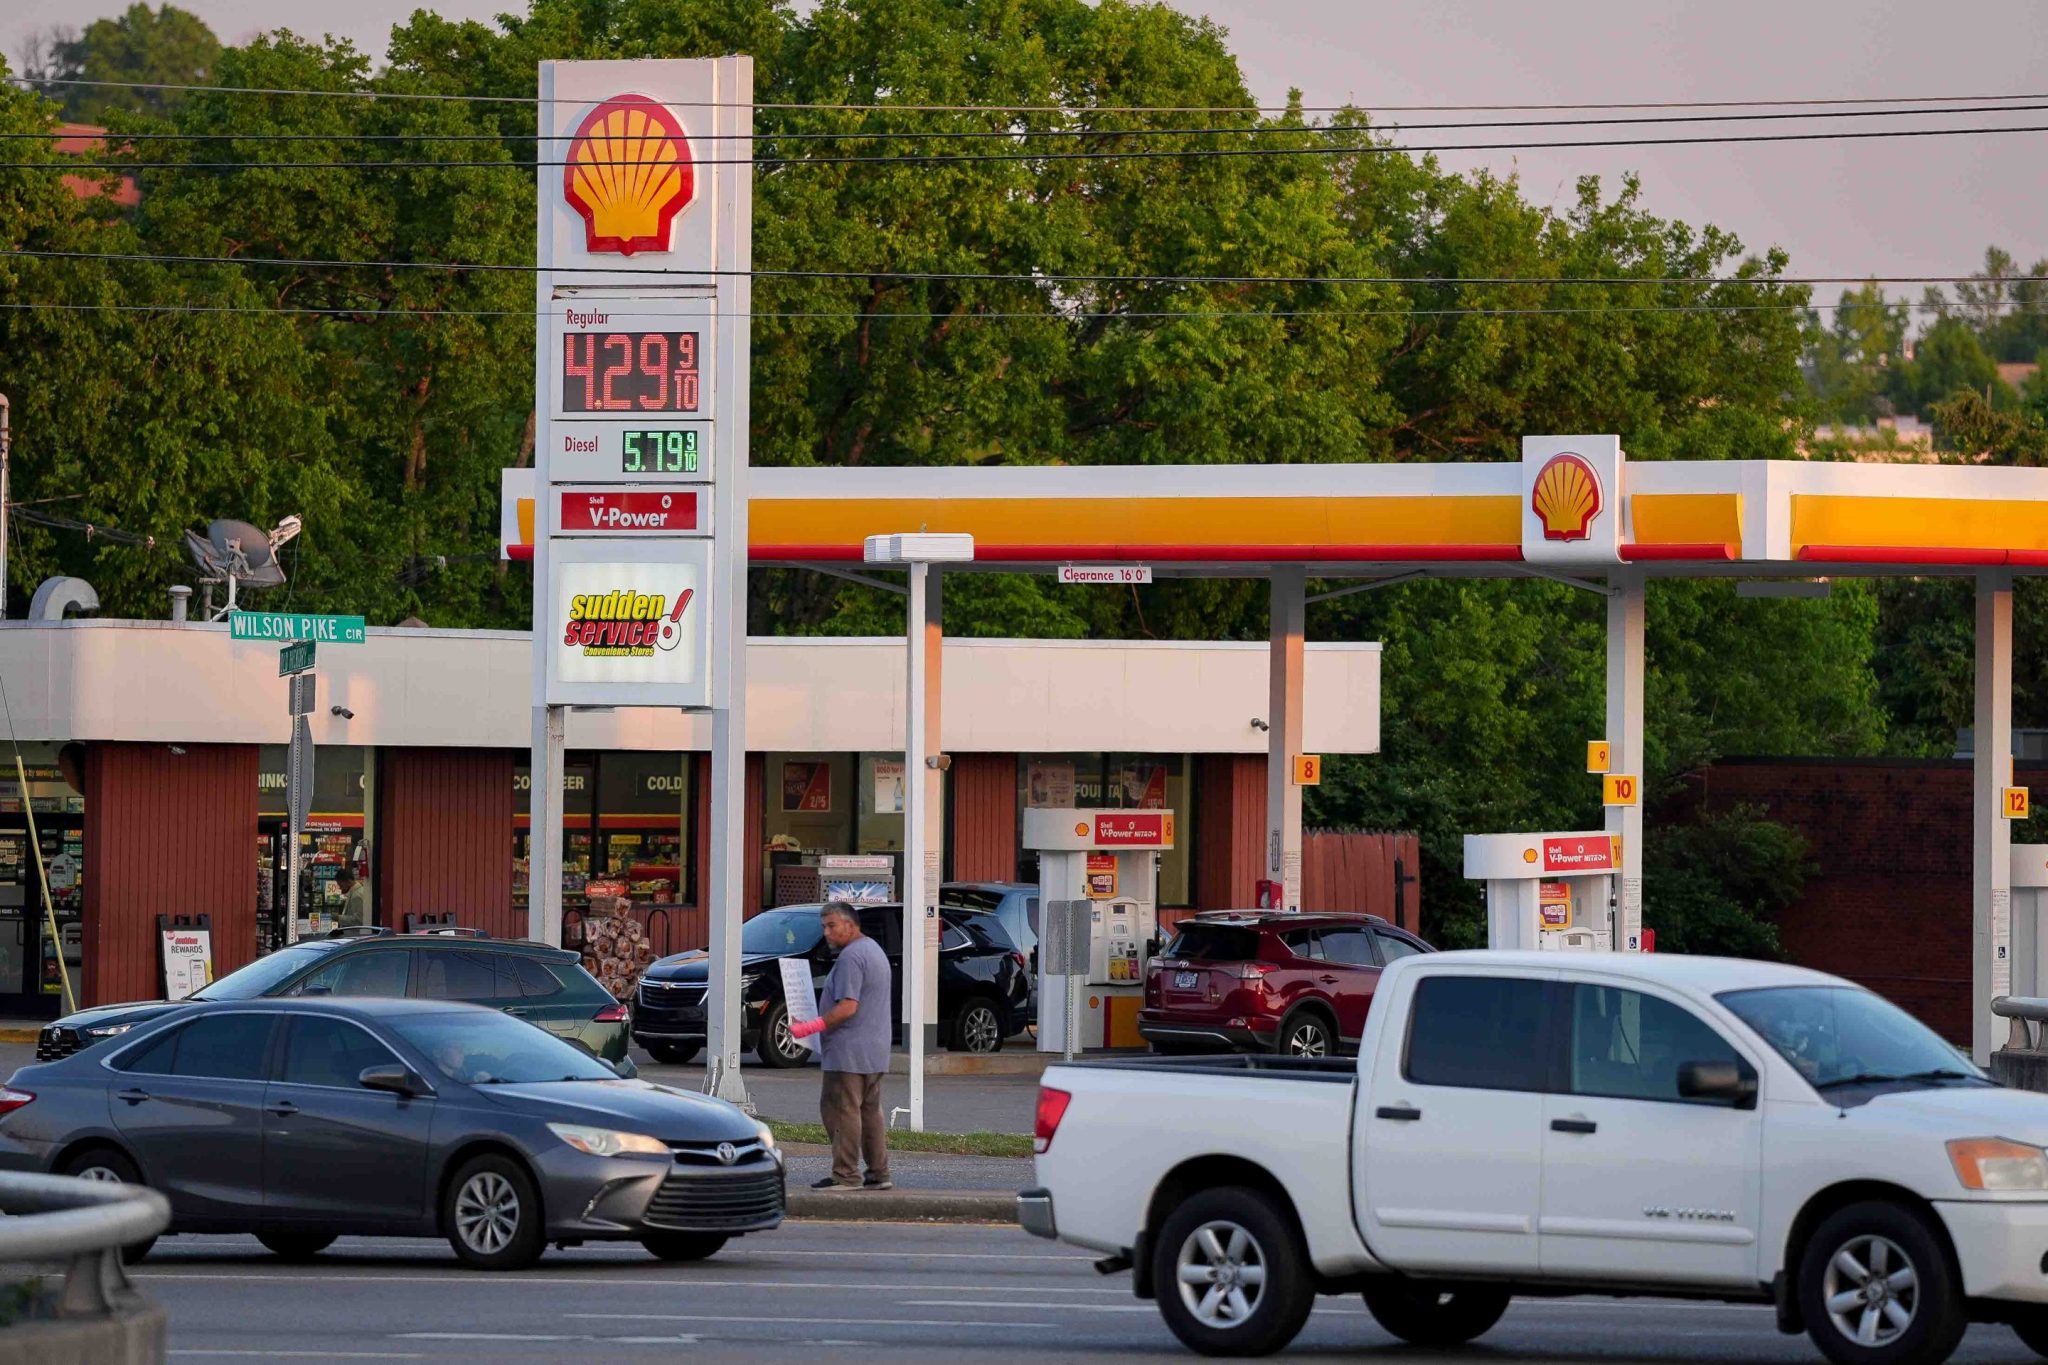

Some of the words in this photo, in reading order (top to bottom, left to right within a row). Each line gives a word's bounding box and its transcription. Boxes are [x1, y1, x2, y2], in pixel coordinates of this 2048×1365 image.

[566, 308, 609, 328] Regular
[566, 334, 668, 410] 4.29
[565, 436, 598, 452] Diesel
[625, 432, 682, 472] 5.79
[588, 508, 668, 526] V-Power
[1064, 568, 1114, 580] Clearance
[1120, 569, 1134, 581] 16'
[570, 590, 666, 620] sudden
[234, 615, 294, 638] WILSON
[302, 618, 338, 640] PIKE
[346, 628, 362, 640] CIR
[584, 646, 630, 656] Convenience
[630, 646, 654, 656] Stores
[1600, 750, 1606, 762] 9
[1304, 760, 1313, 778] 8
[258, 774, 288, 788] INK
[563, 776, 584, 790] EER
[647, 776, 682, 790] COLD
[1615, 780, 1632, 798] 10
[2010, 793, 2024, 811] 12
[1100, 830, 1132, 838] V-Power
[1166, 822, 1171, 836] 8
[1549, 853, 1582, 863] V-Power
[171, 945, 203, 954] REWARDS
